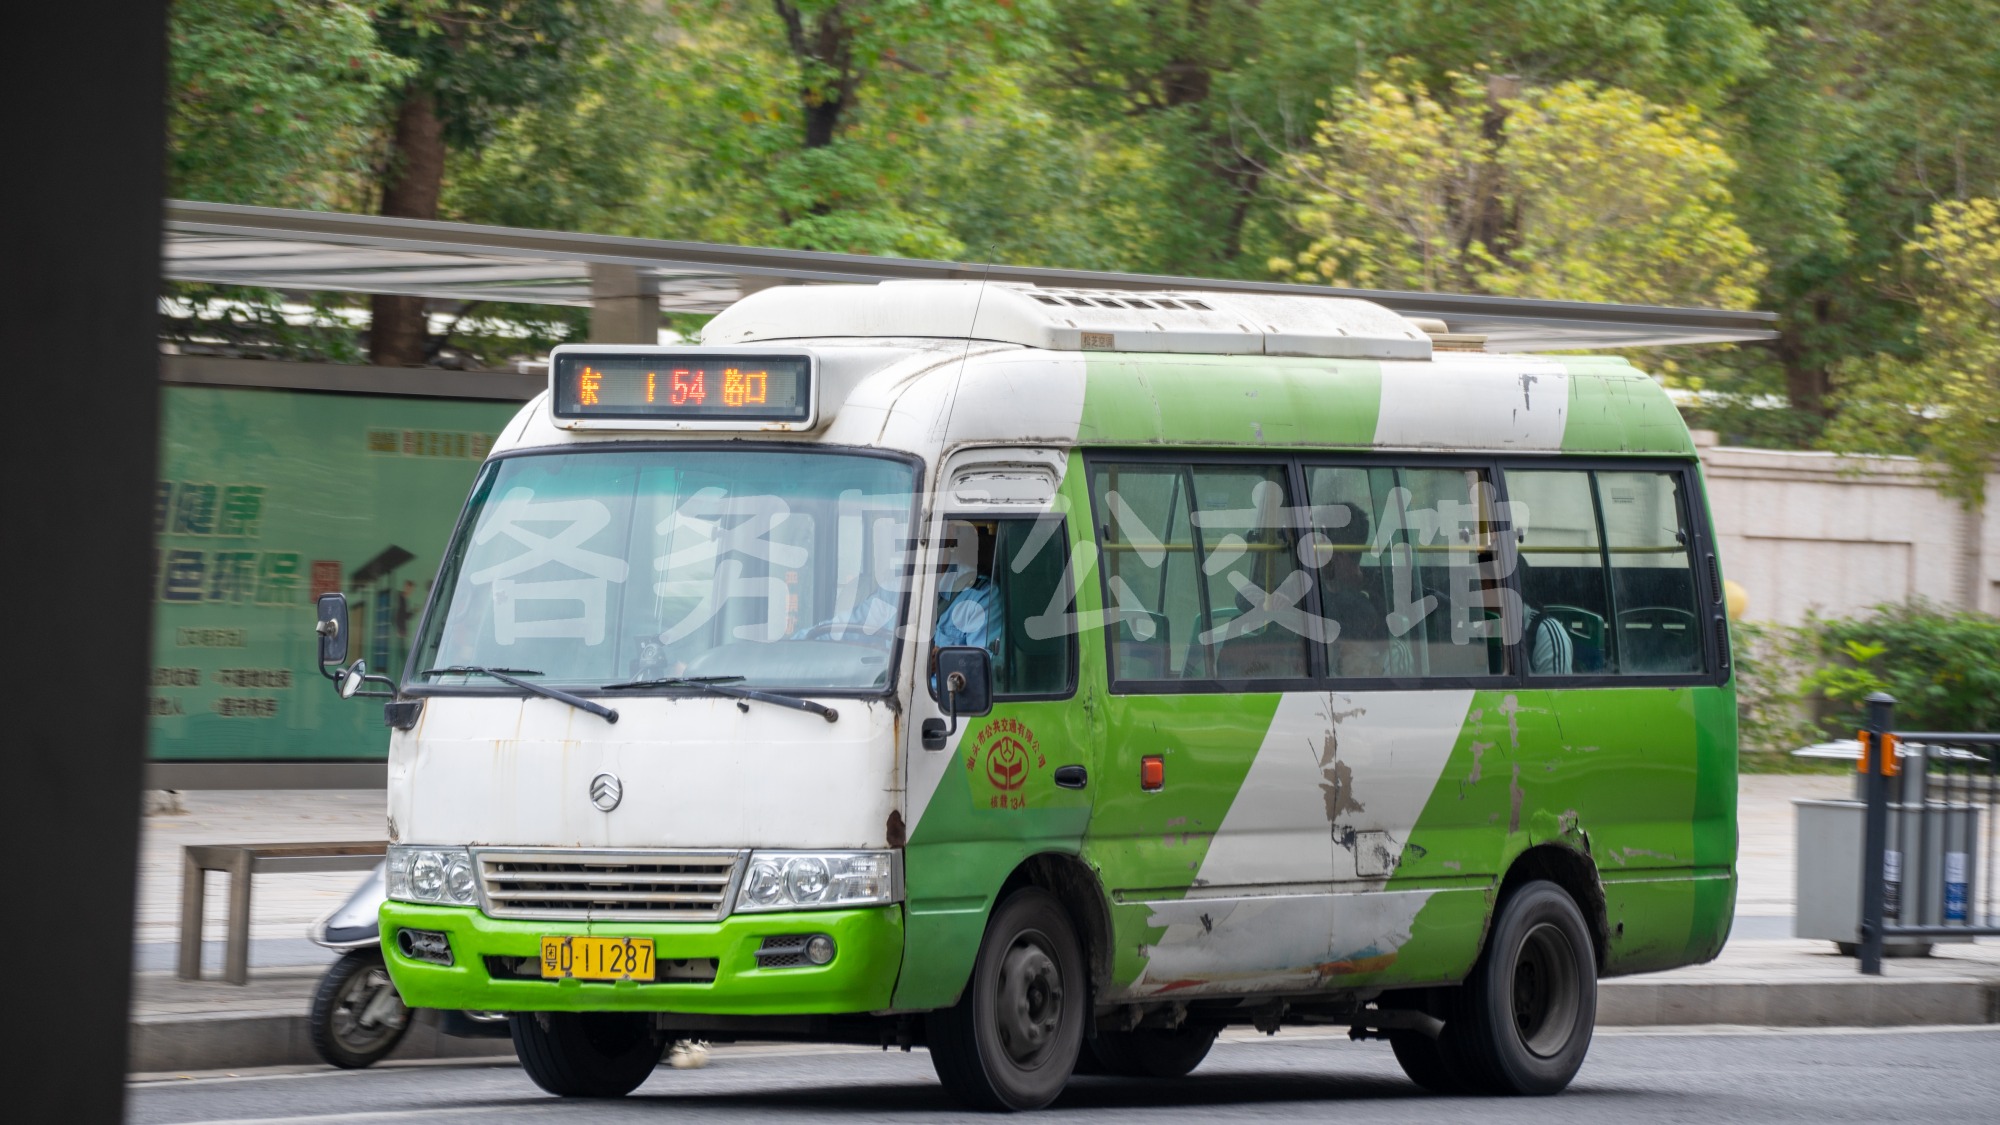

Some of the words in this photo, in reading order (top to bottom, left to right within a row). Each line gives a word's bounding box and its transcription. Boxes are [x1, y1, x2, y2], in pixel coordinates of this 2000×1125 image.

[672, 369, 707, 405] 54
[966, 717, 1047, 773] 汕头市公共交通有限公司
